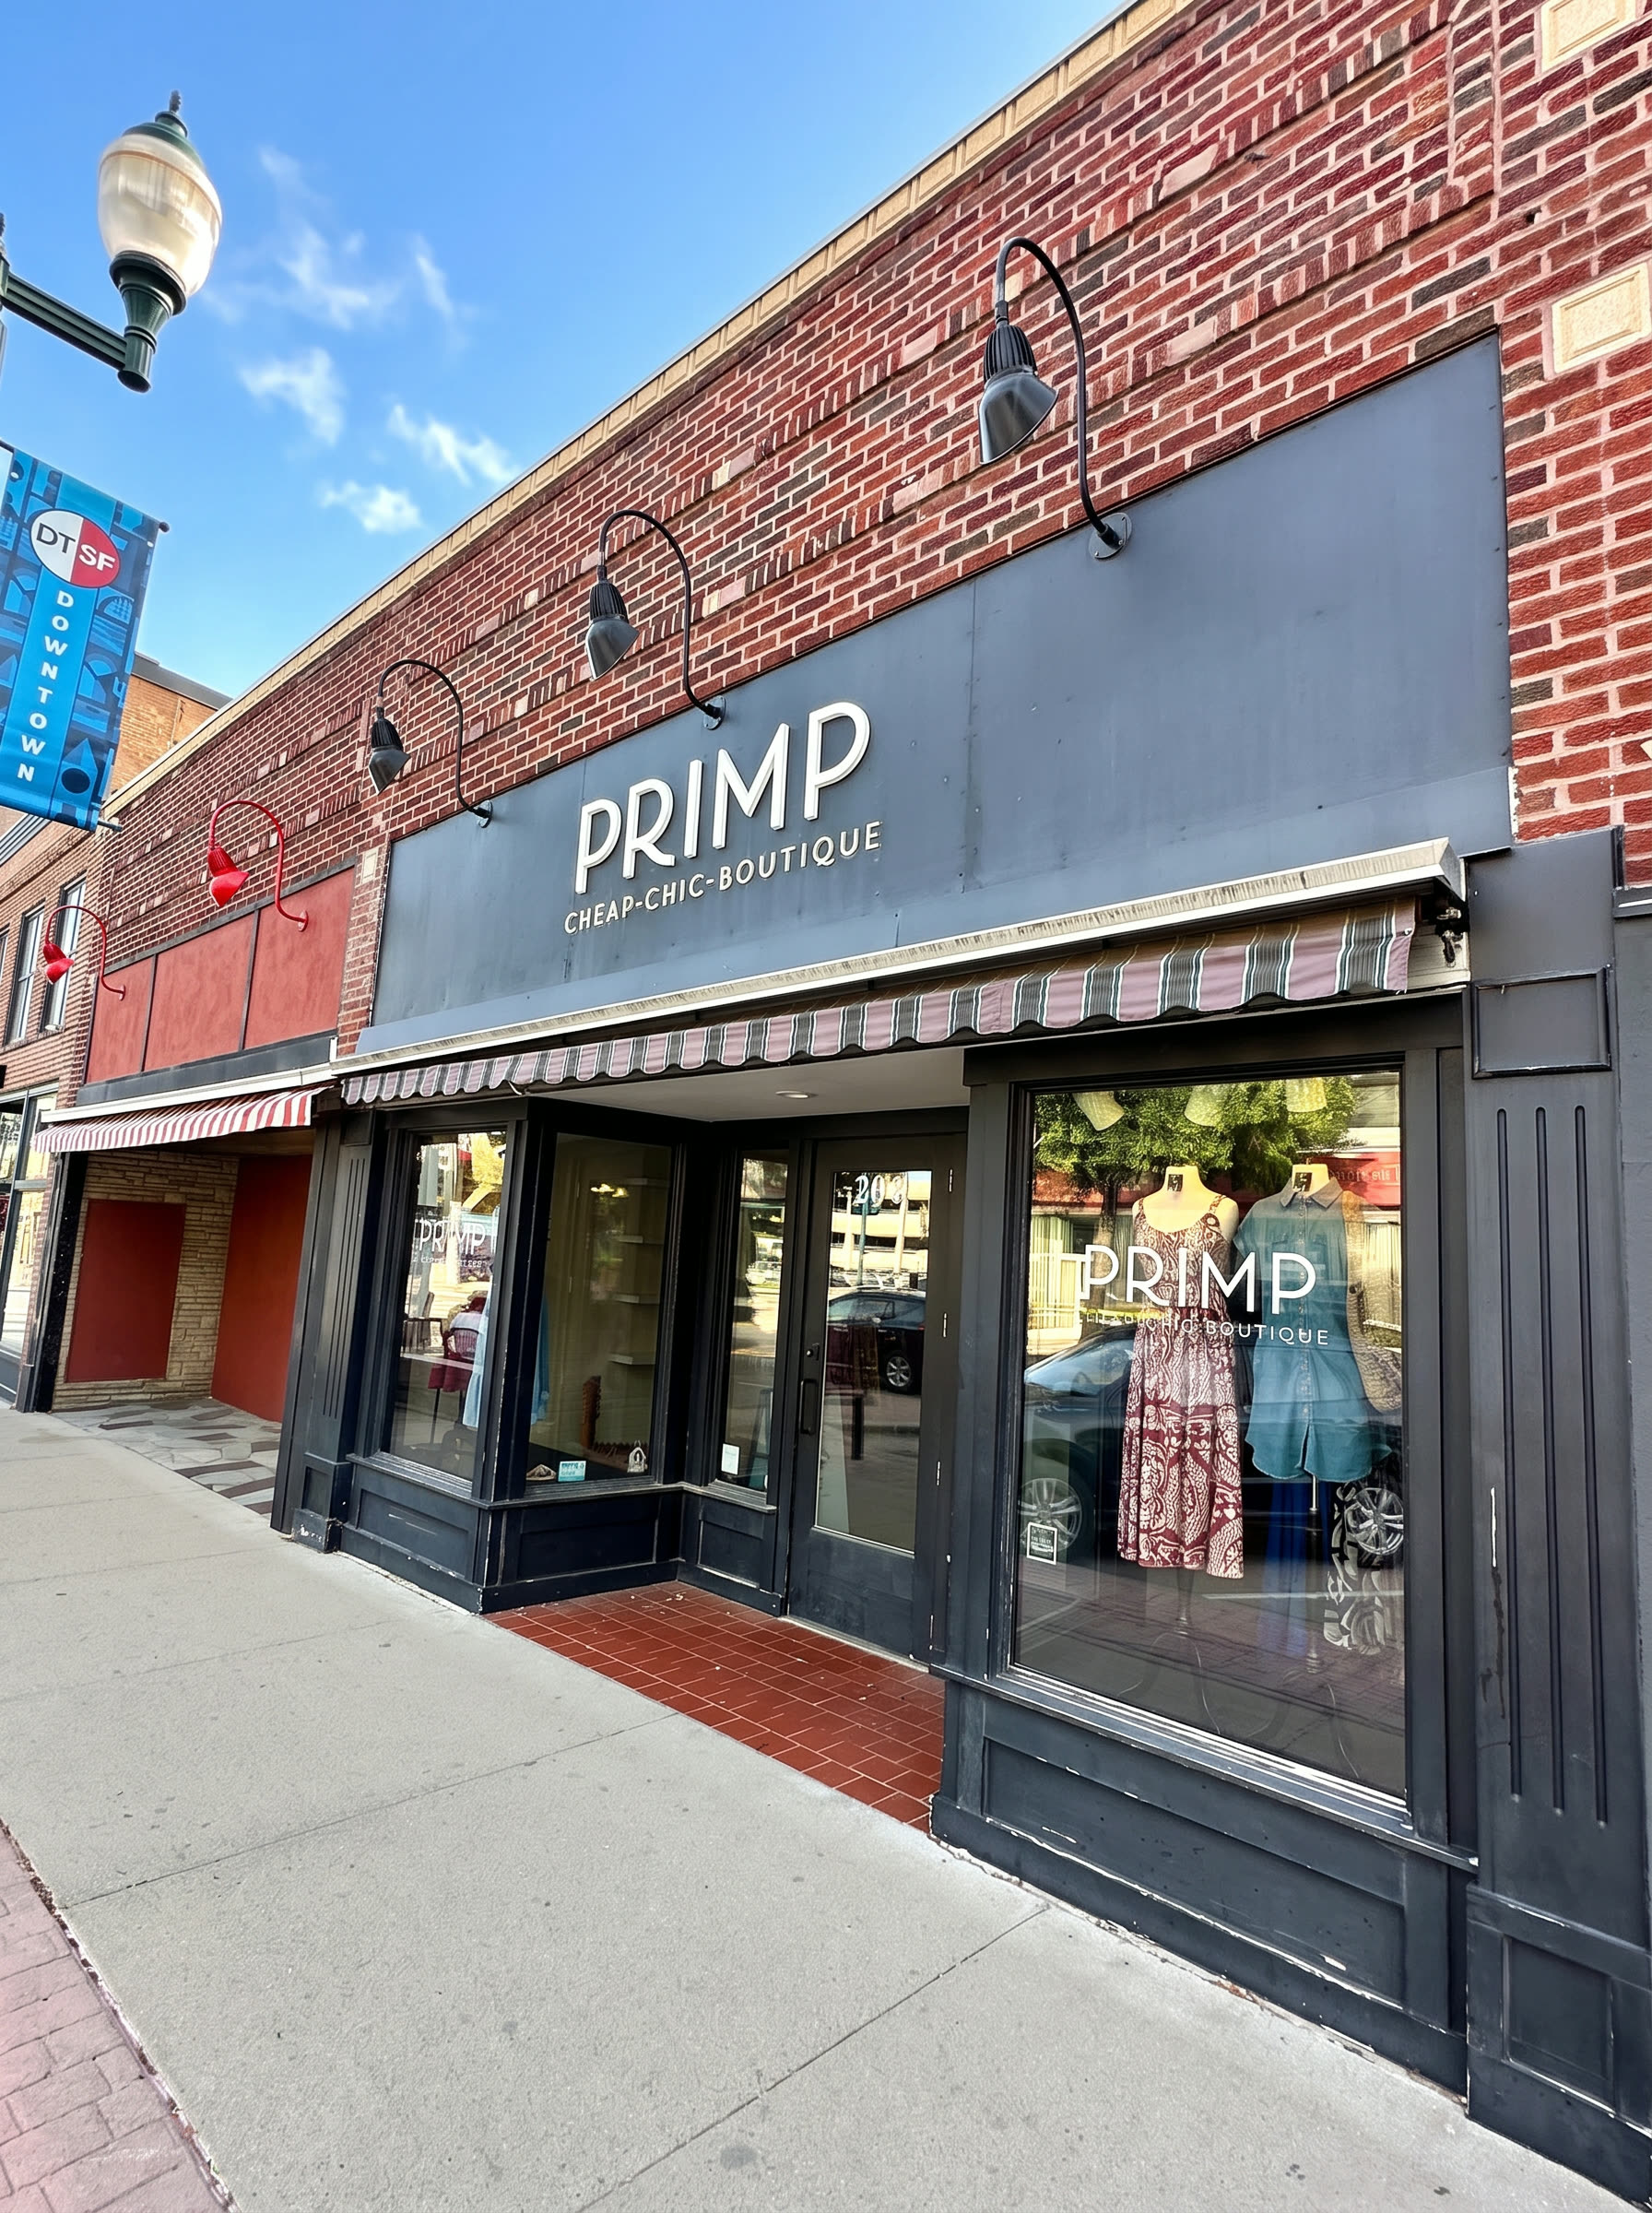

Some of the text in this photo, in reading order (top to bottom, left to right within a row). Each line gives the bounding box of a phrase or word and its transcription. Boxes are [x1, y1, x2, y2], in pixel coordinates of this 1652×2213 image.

[17, 590, 75, 782] DOWNTOWN
[574, 701, 871, 895] PRIMP
[1080, 1244, 1316, 1315] PRIMP
